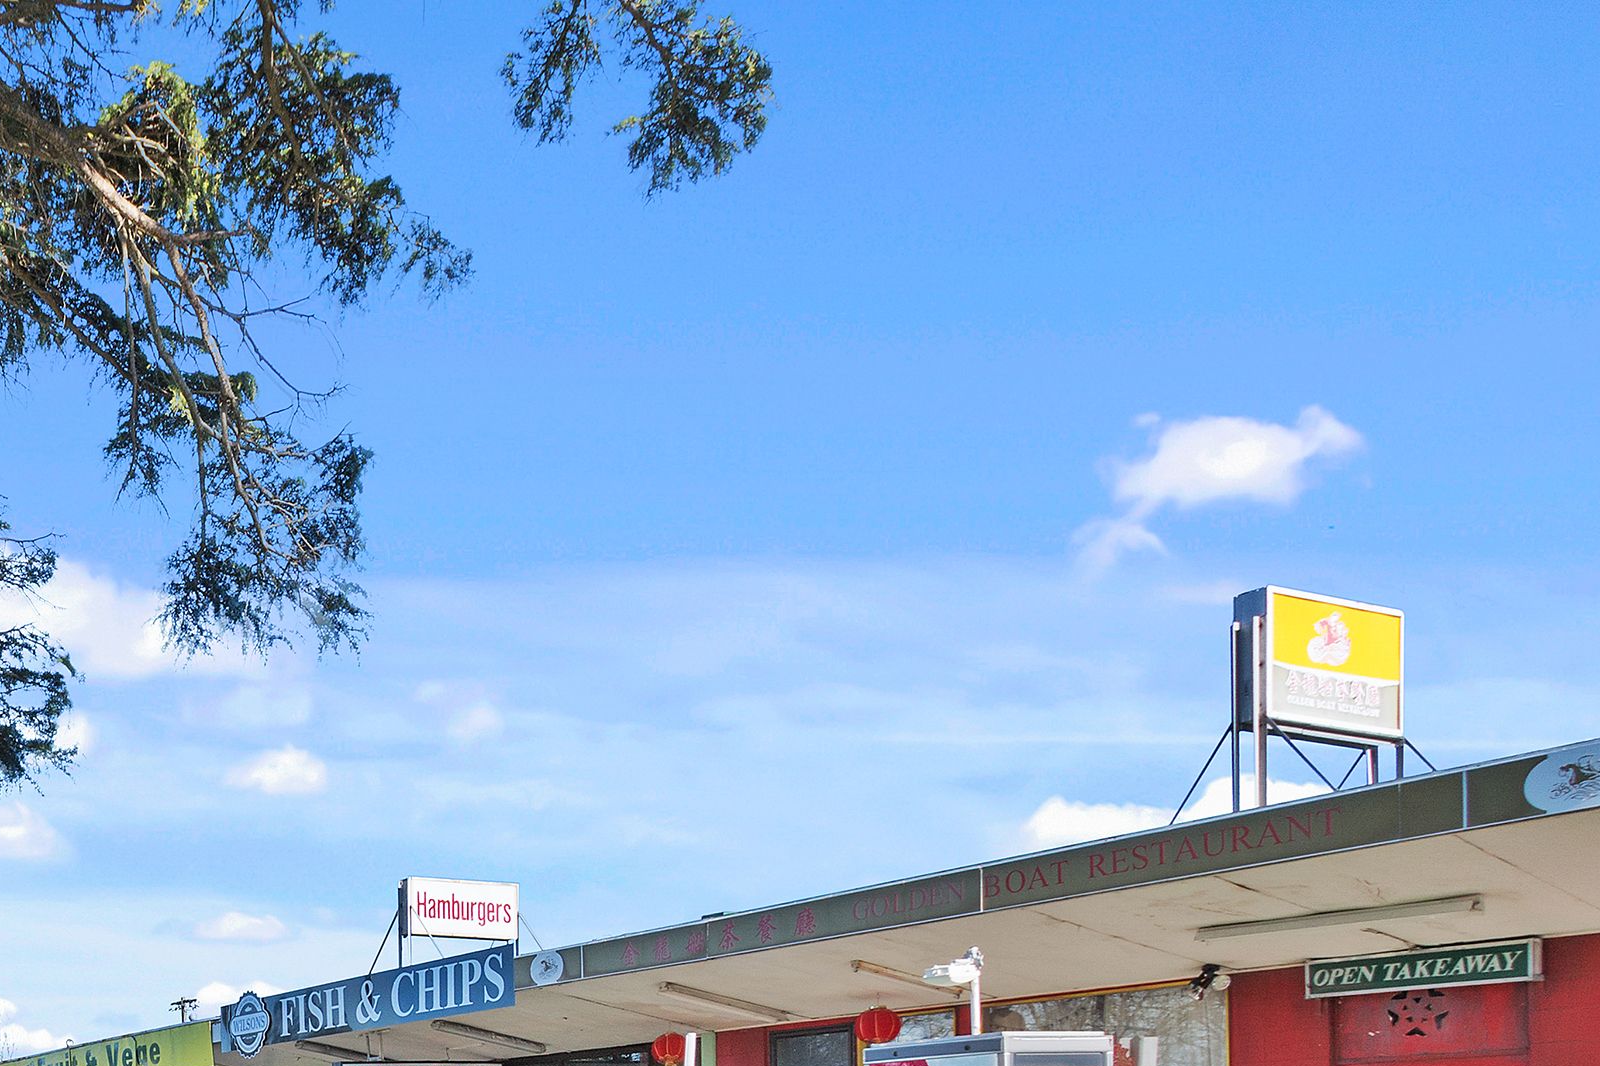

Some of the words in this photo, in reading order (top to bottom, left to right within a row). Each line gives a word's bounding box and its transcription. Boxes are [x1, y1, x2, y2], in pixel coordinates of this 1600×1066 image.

[852, 880, 966, 921] GOLDEN
[983, 859, 1069, 898] BOAT
[1088, 806, 1343, 879] RESTAURANT
[416, 890, 512, 927] Hamburgers
[1313, 963, 1376, 987] OPEN
[1383, 950, 1523, 982] TAKEAWAY
[279, 985, 348, 1038] FISH
[356, 979, 382, 1025] &
[390, 952, 506, 1018] CHIPS
[233, 1014, 266, 1033] WILSONS
